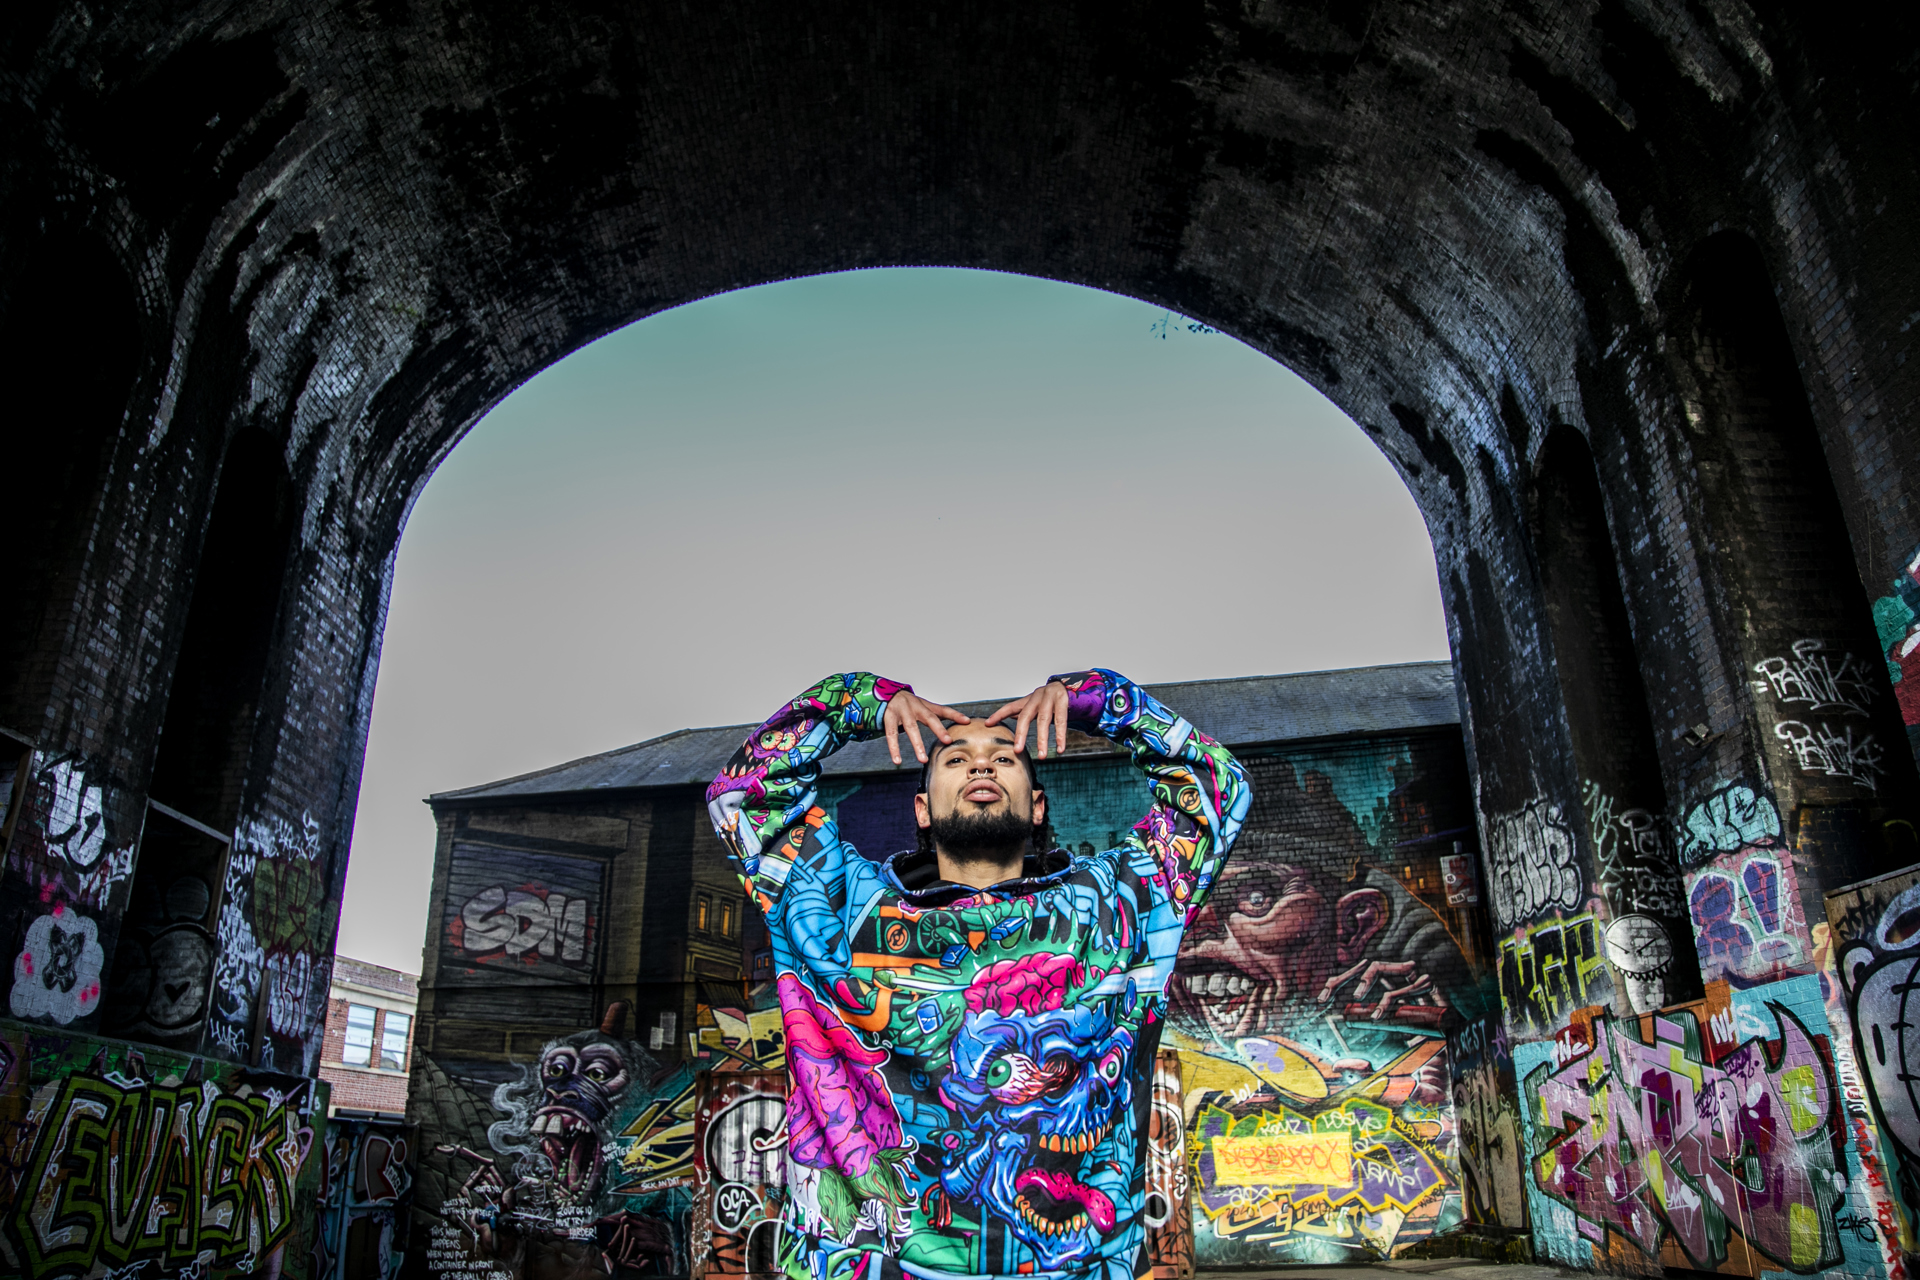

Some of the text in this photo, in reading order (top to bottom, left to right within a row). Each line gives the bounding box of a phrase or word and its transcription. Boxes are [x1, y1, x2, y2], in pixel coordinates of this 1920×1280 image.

[461, 885, 588, 963] SDM
[1710, 1001, 1771, 1046] NHS
[720, 1188, 751, 1218] OCA
[429, 1225, 445, 1237] THIS
[426, 1249, 443, 1259] WHEN
[431, 1237, 462, 1250] HAPPENS
